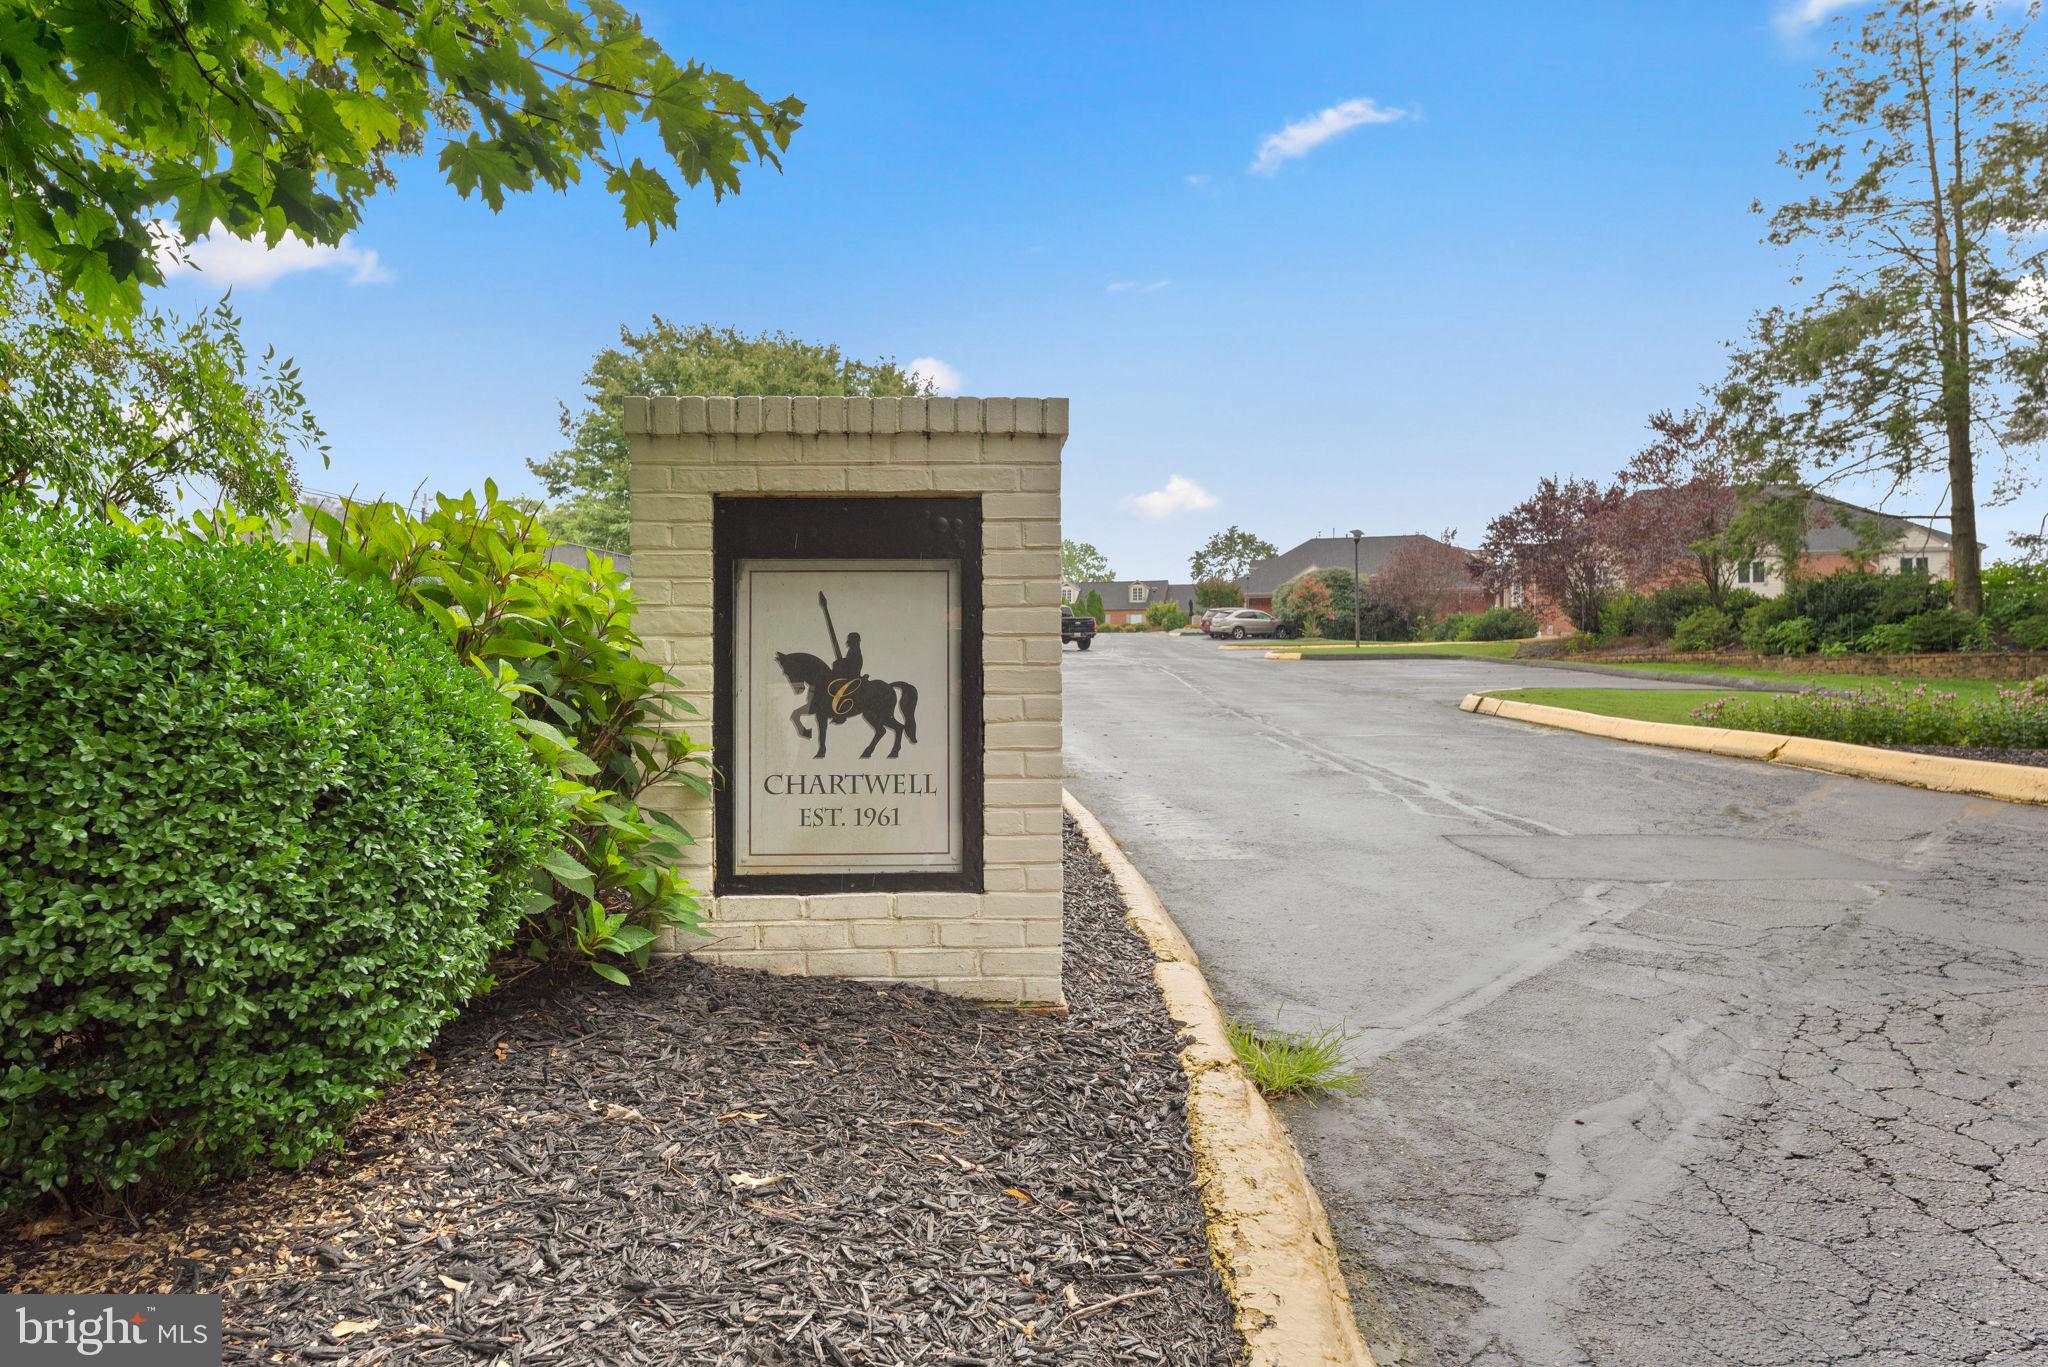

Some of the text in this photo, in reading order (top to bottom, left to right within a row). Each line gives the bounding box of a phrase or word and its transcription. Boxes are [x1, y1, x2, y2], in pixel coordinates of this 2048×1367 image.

[763, 773, 938, 797] CHARTWELL
[798, 806, 901, 828] EST. 1961
